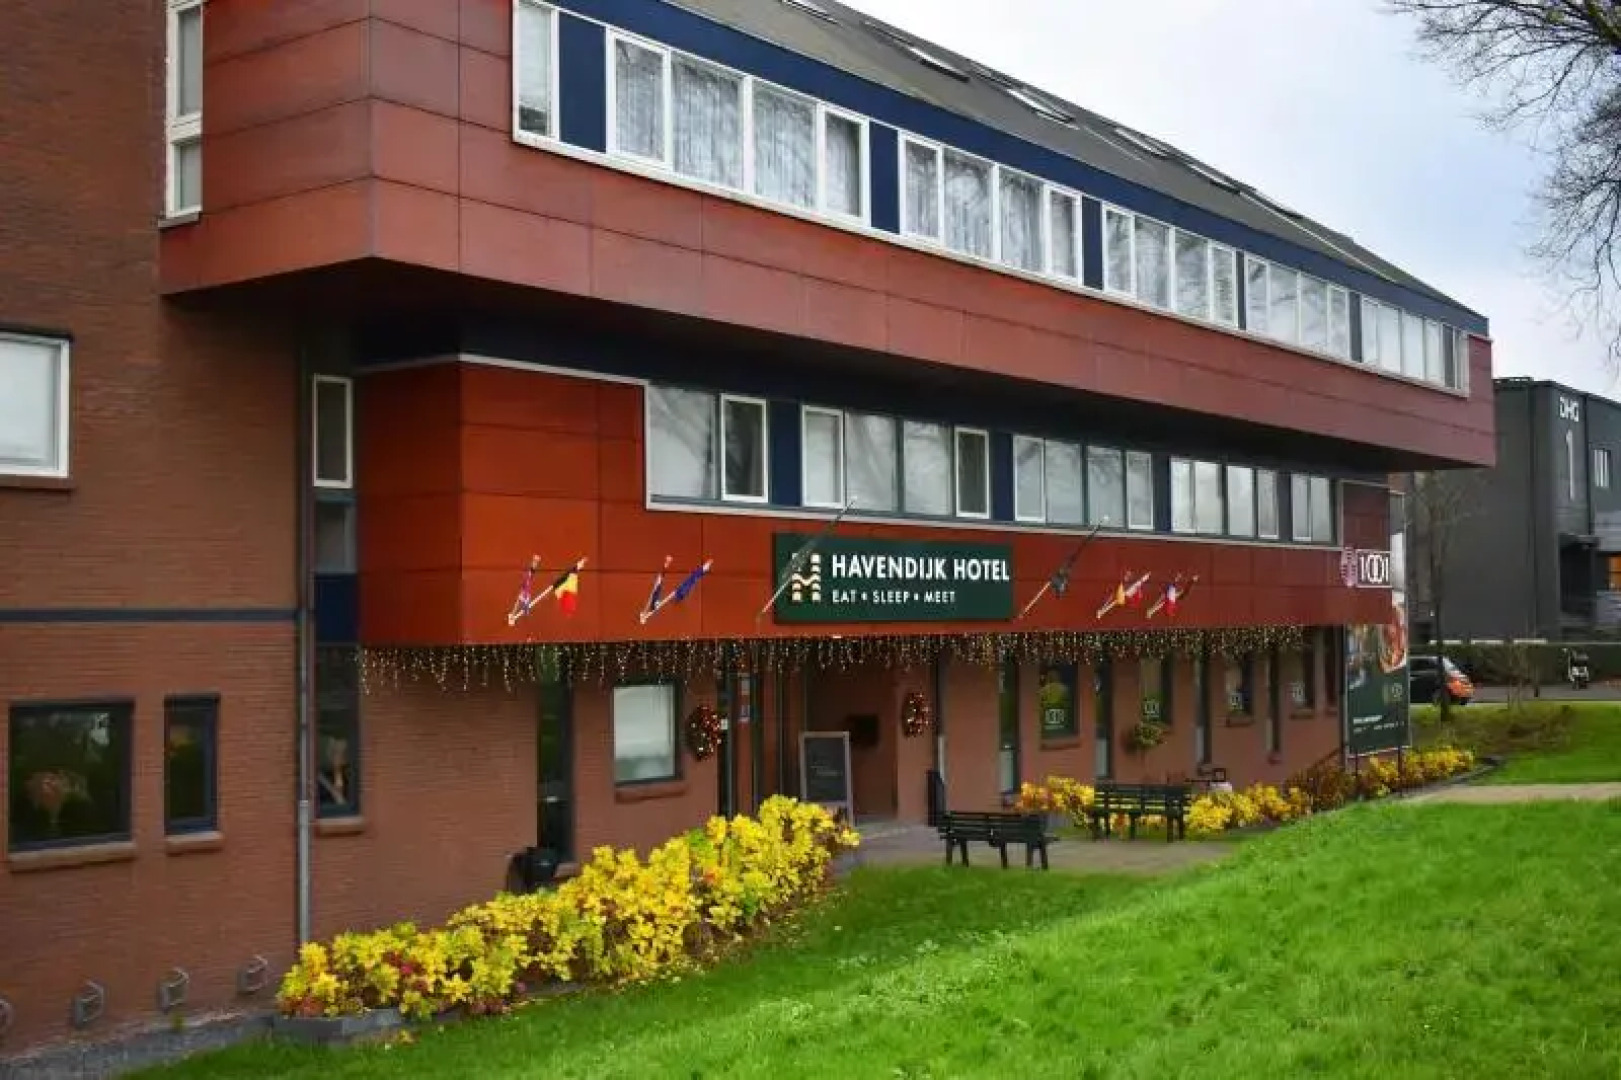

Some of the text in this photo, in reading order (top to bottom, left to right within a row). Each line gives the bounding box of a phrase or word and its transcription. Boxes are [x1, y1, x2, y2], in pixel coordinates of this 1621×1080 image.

[833, 554, 1010, 581] HAVENDIJK HOTEL
[832, 590, 956, 604] EAT SLEEP MEET
